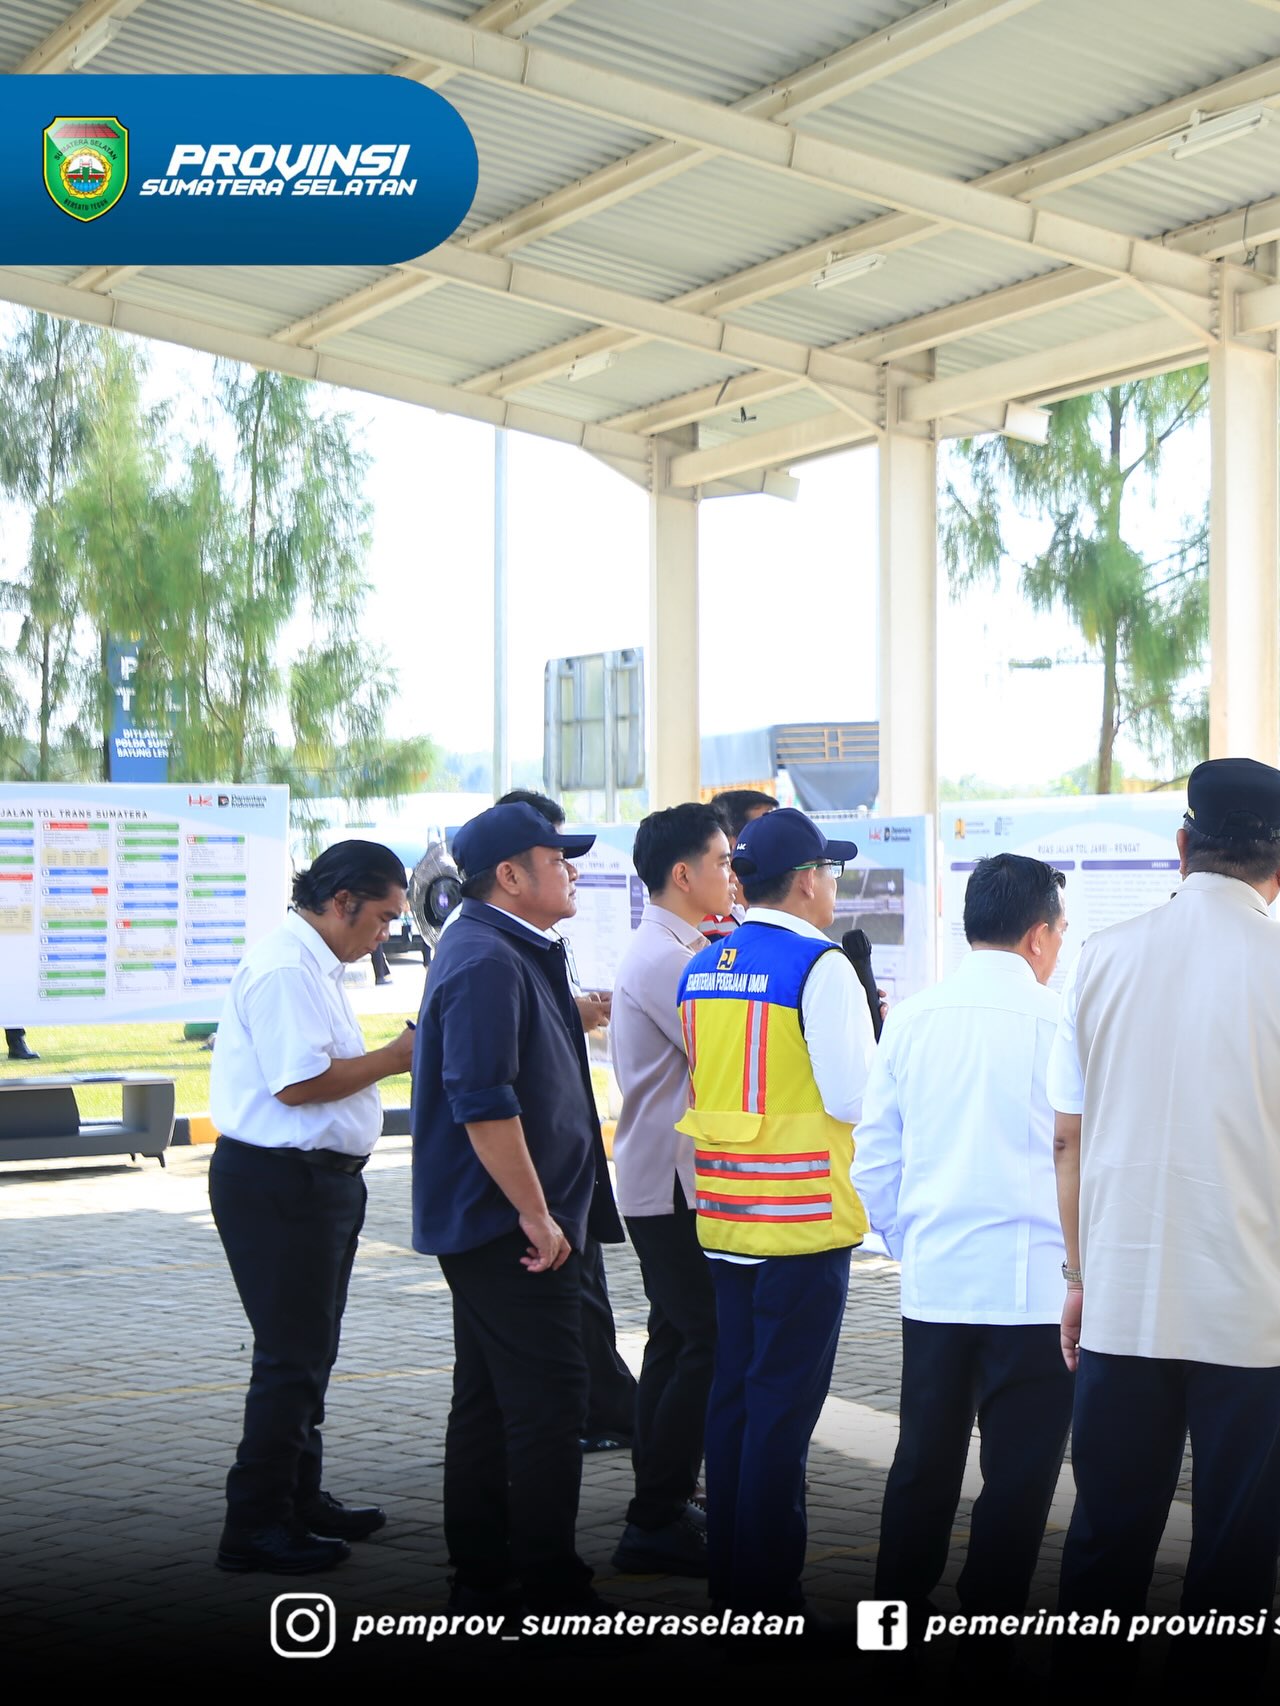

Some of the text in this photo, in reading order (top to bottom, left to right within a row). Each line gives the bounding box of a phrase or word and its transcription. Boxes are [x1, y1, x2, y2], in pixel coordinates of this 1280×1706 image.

[37, 809, 56, 818] TOL
[60, 810, 92, 819] TRANS
[96, 810, 149, 820] SUMATERA
[716, 973, 747, 992] PEKERJAAN
[747, 974, 769, 993] UMUM
